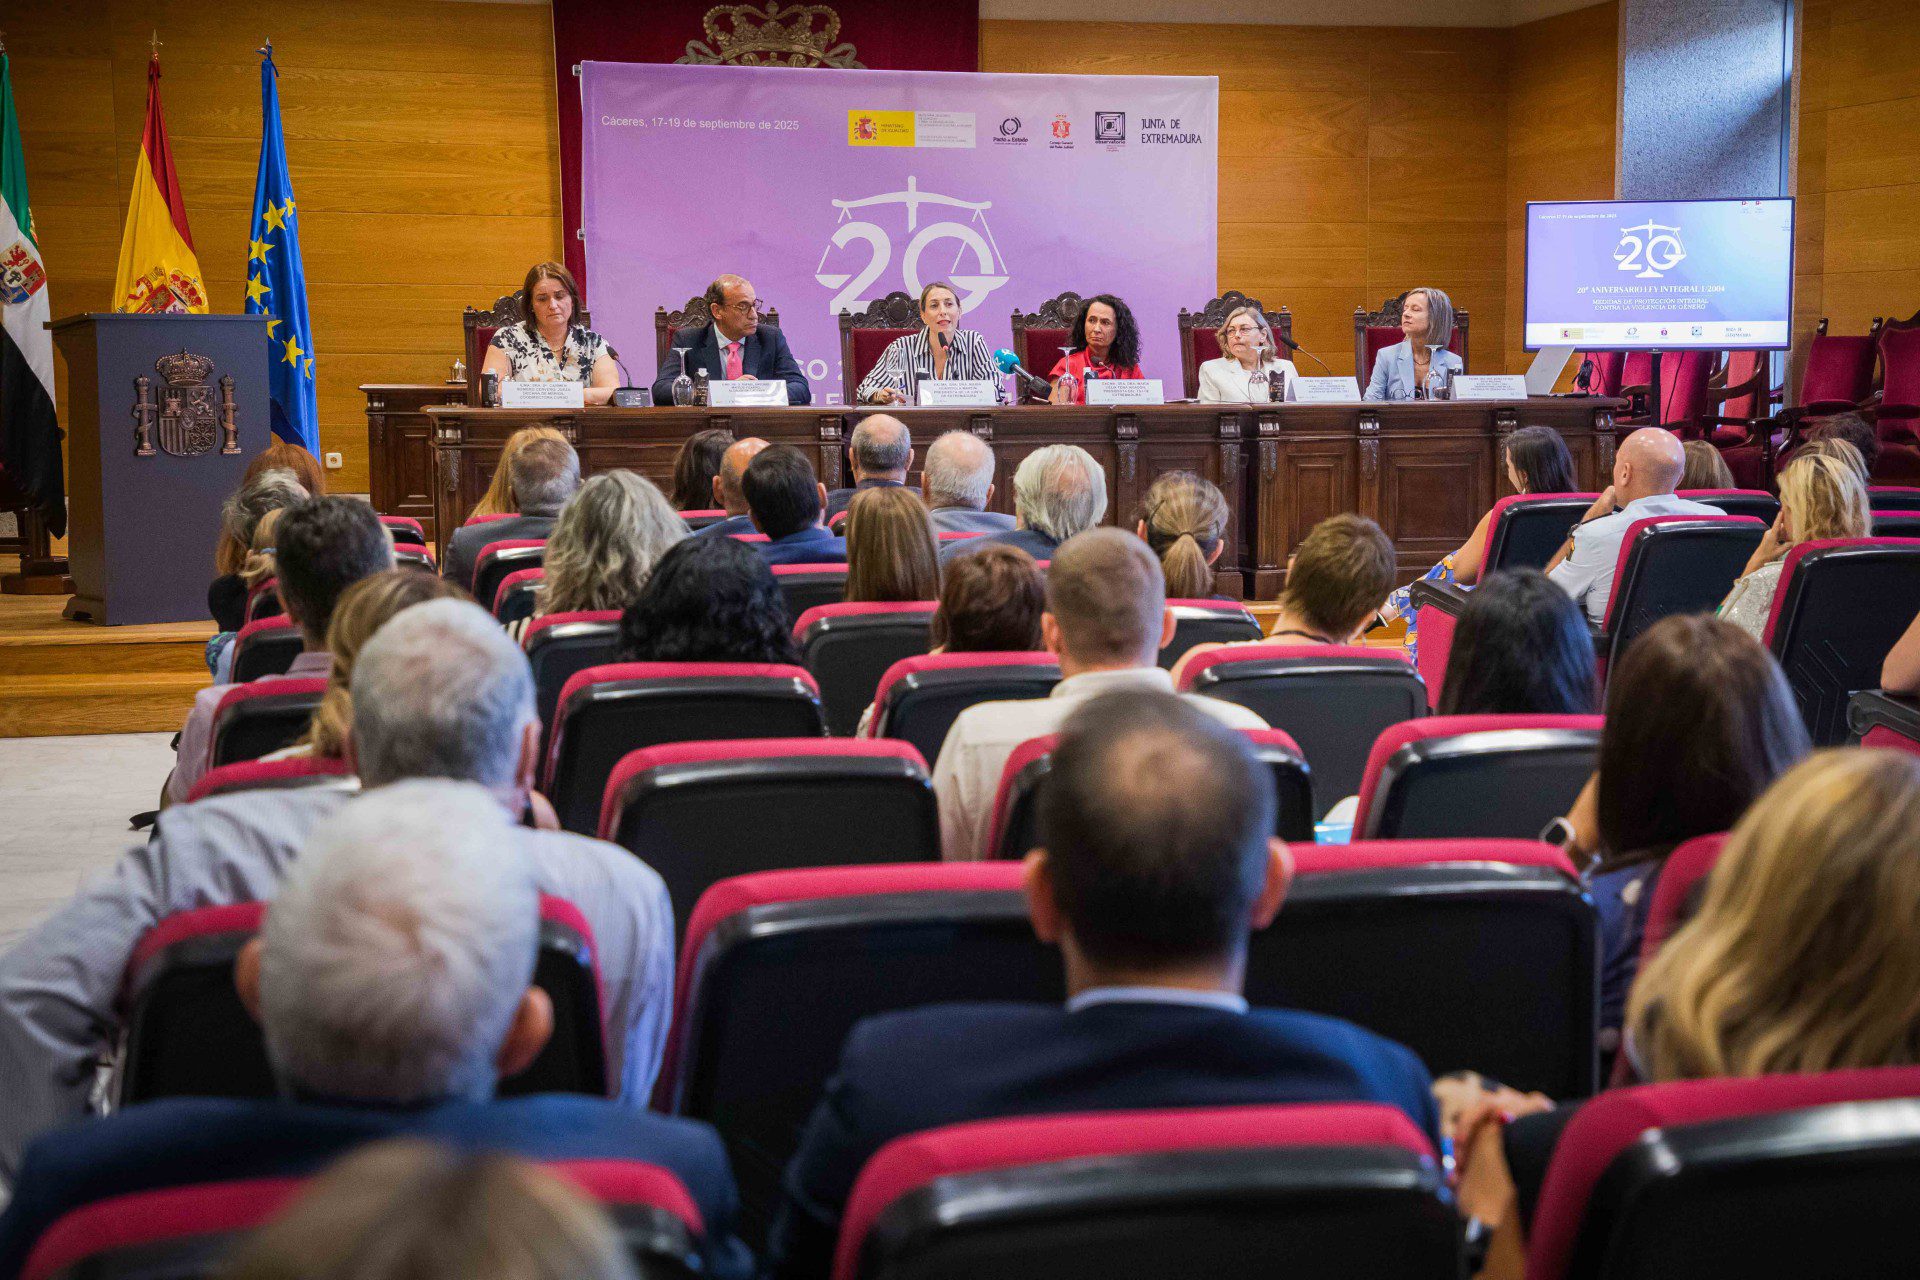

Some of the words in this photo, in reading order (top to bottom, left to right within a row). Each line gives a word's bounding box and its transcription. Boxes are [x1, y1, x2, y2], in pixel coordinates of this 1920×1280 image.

[601, 116, 648, 128] Cáceres,
[651, 118, 680, 128] 17-19
[684, 118, 696, 128] de
[699, 118, 755, 130] septiembre
[758, 120, 771, 130] de
[774, 120, 800, 130] 2025
[1141, 119, 1166, 130] JUNTA
[1170, 119, 1180, 129] DE
[1141, 134, 1202, 144] EXTREMADURA
[1618, 234, 1682, 270] 20
